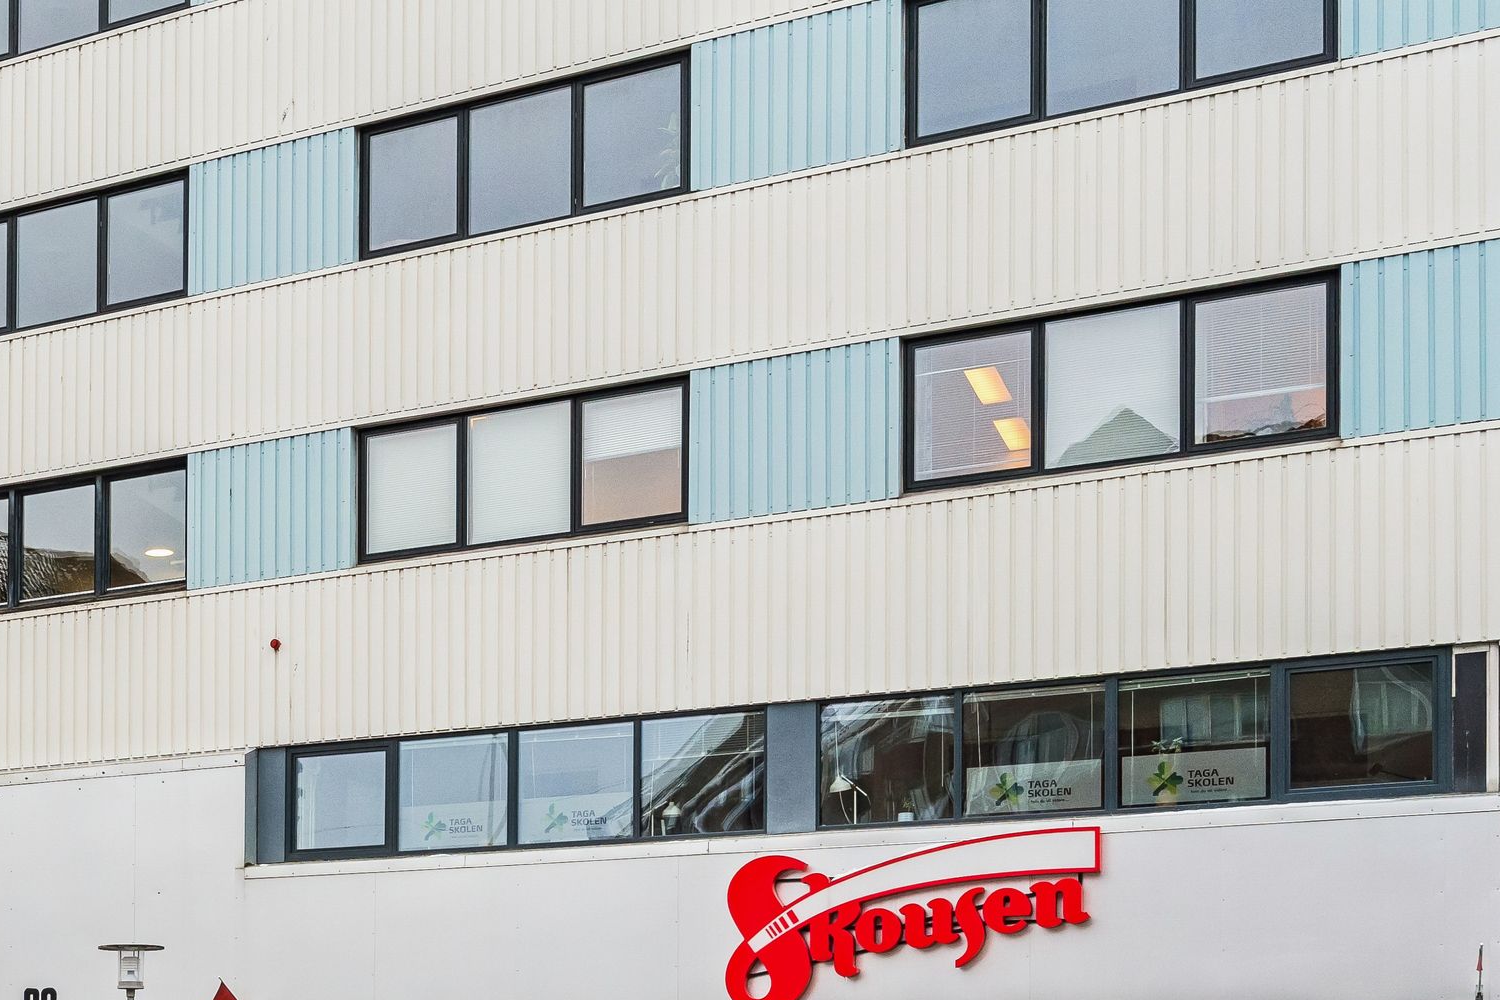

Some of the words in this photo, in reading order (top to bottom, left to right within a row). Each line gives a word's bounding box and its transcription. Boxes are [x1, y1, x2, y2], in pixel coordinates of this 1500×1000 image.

[1188, 769, 1219, 778] TAGA
[1028, 780, 1058, 788] TAGA
[1187, 777, 1234, 787] SKOLEN
[1028, 787, 1072, 798] SKOLEN
[571, 810, 596, 818] TAGA
[449, 818, 472, 826] TAGA
[571, 817, 607, 826] SKOLEN
[449, 824, 483, 834] SKOLEN
